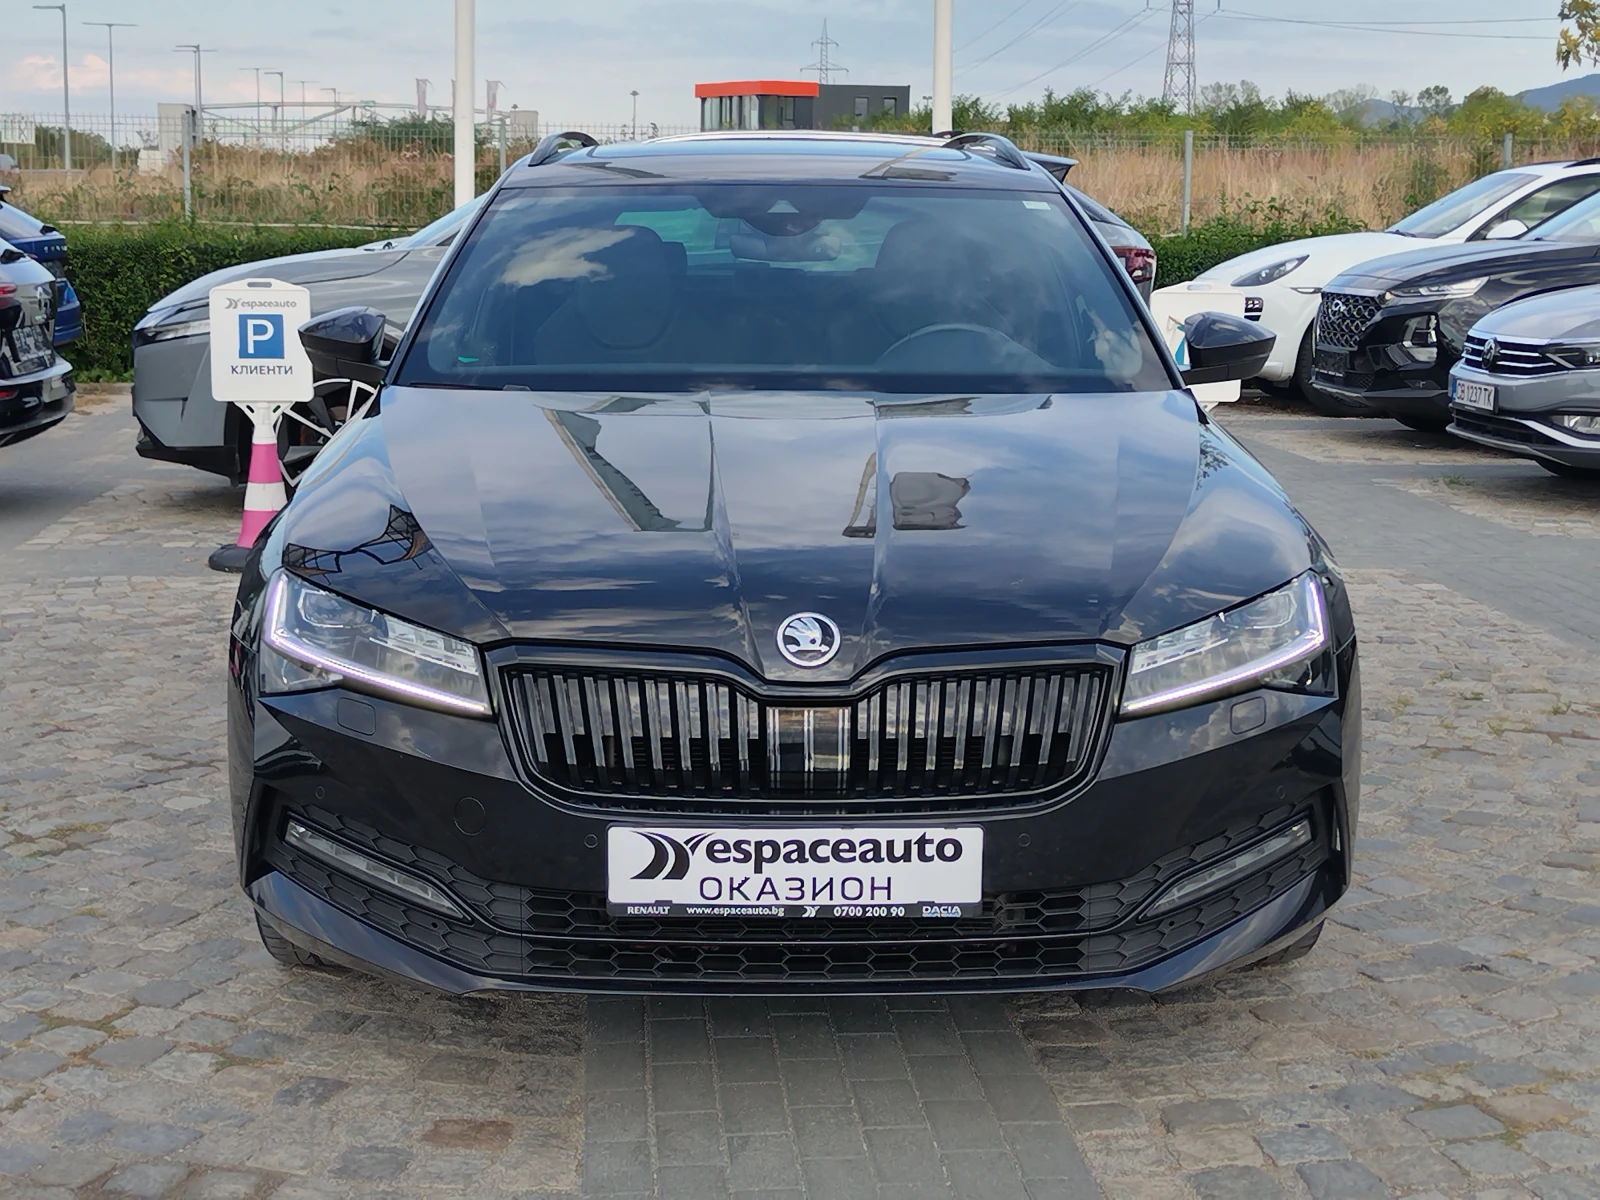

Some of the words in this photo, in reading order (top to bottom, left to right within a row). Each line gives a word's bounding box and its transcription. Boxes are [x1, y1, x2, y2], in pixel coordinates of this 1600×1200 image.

[241, 299, 297, 310] espaceauto
[247, 319, 275, 354] P
[231, 365, 293, 375] КЛИЕНТИ
[705, 831, 963, 874] espaceauto
[700, 876, 892, 902] ОКАЗИОН
[627, 906, 670, 915] RENAULT
[686, 906, 785, 917] www.espaceauto.bg
[833, 906, 862, 917] 0700
[865, 906, 887, 917] 200
[890, 906, 905, 917] 90
[922, 905, 961, 914] DACIA
